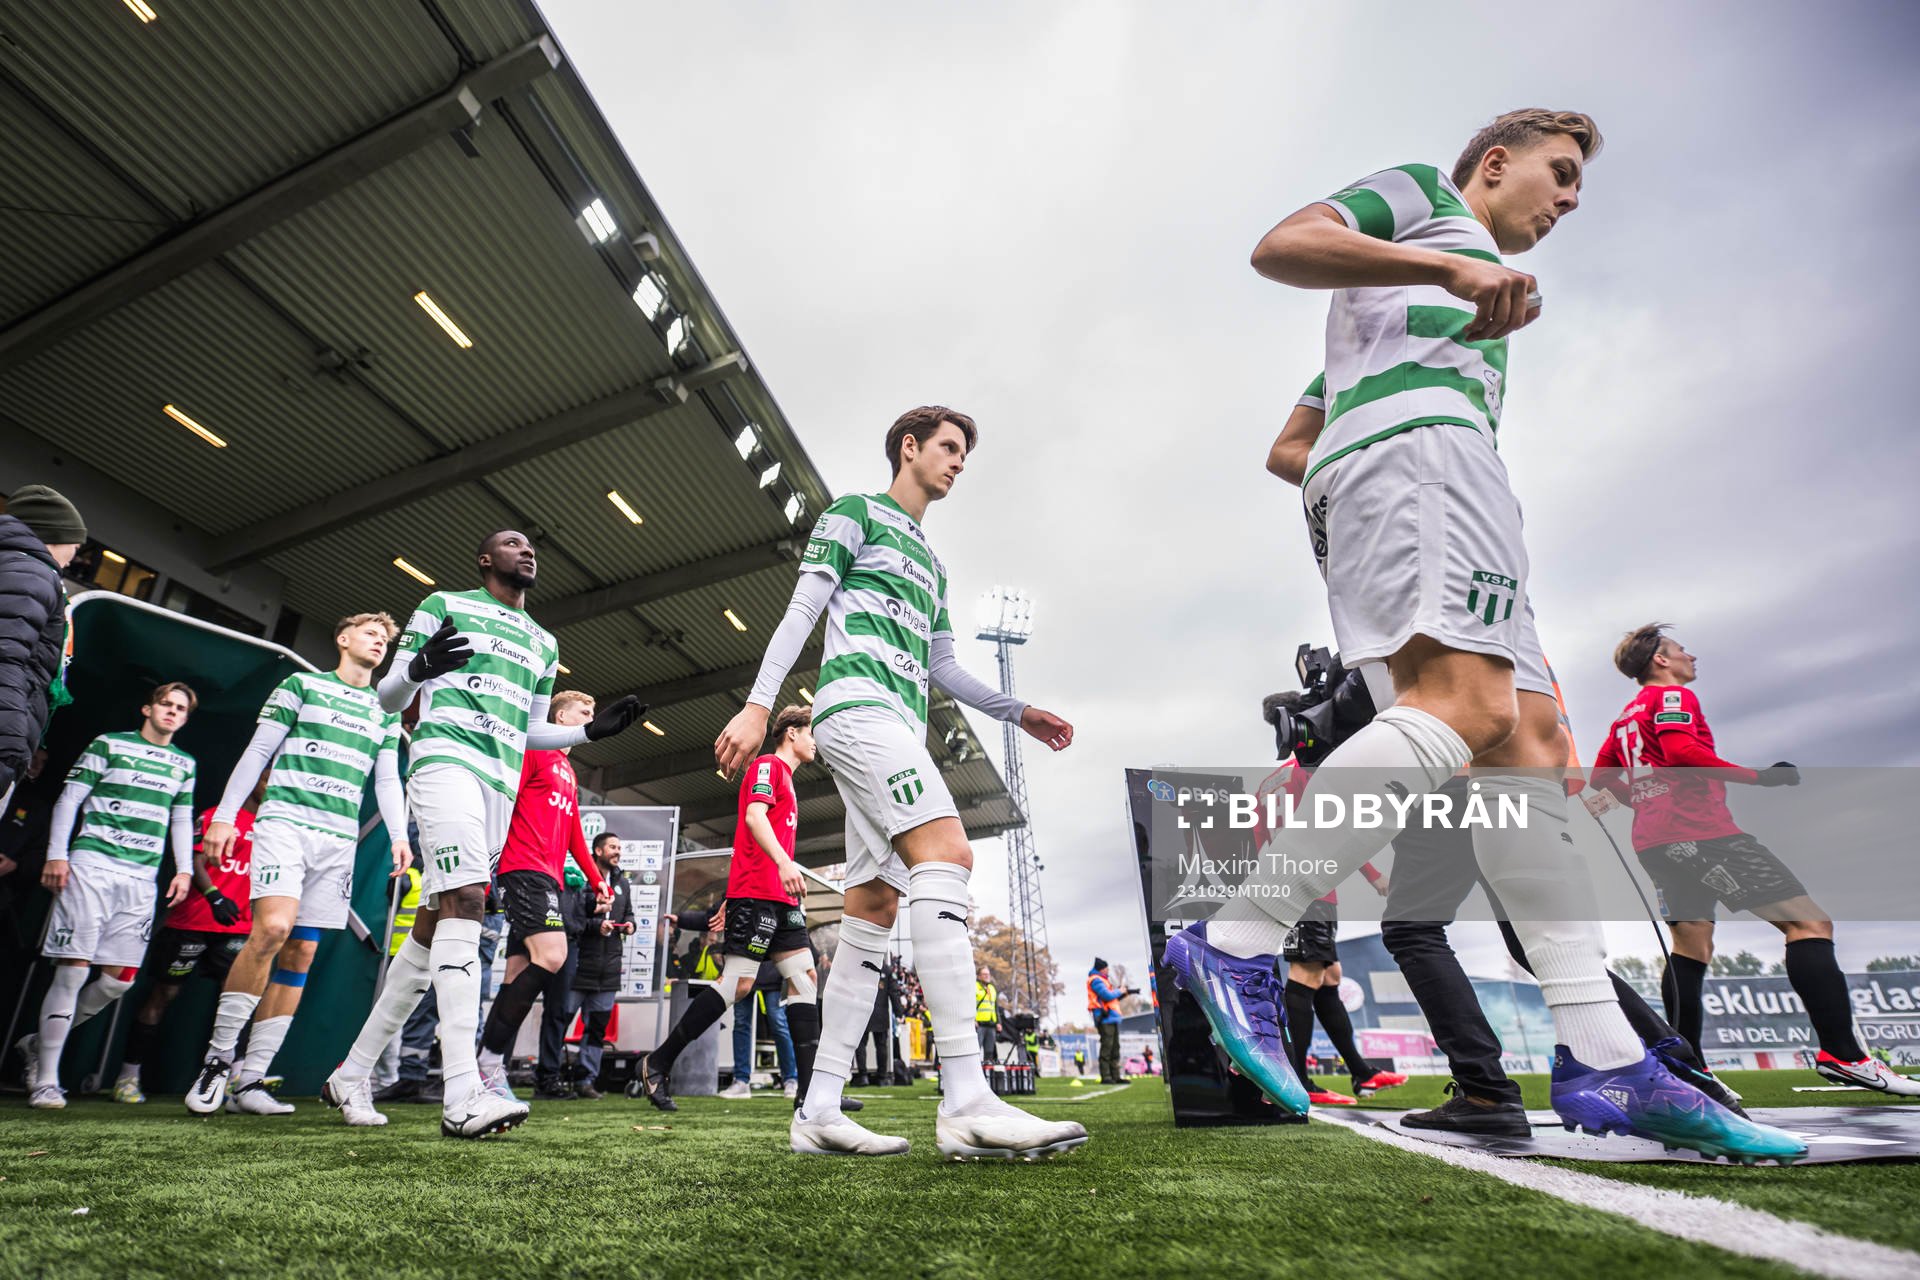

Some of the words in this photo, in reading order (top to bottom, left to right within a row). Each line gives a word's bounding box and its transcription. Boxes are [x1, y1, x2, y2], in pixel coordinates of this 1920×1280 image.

[807, 543, 828, 555] BET
[1481, 573, 1511, 587] VSK
[891, 771, 912, 782] VSK
[1702, 985, 1808, 1016] eklun
[1717, 1027, 1744, 1043] EN
[1747, 1026, 1784, 1043] DEL
[1787, 1026, 1811, 1042] AV
[1862, 1024, 1920, 1041] DGRU
